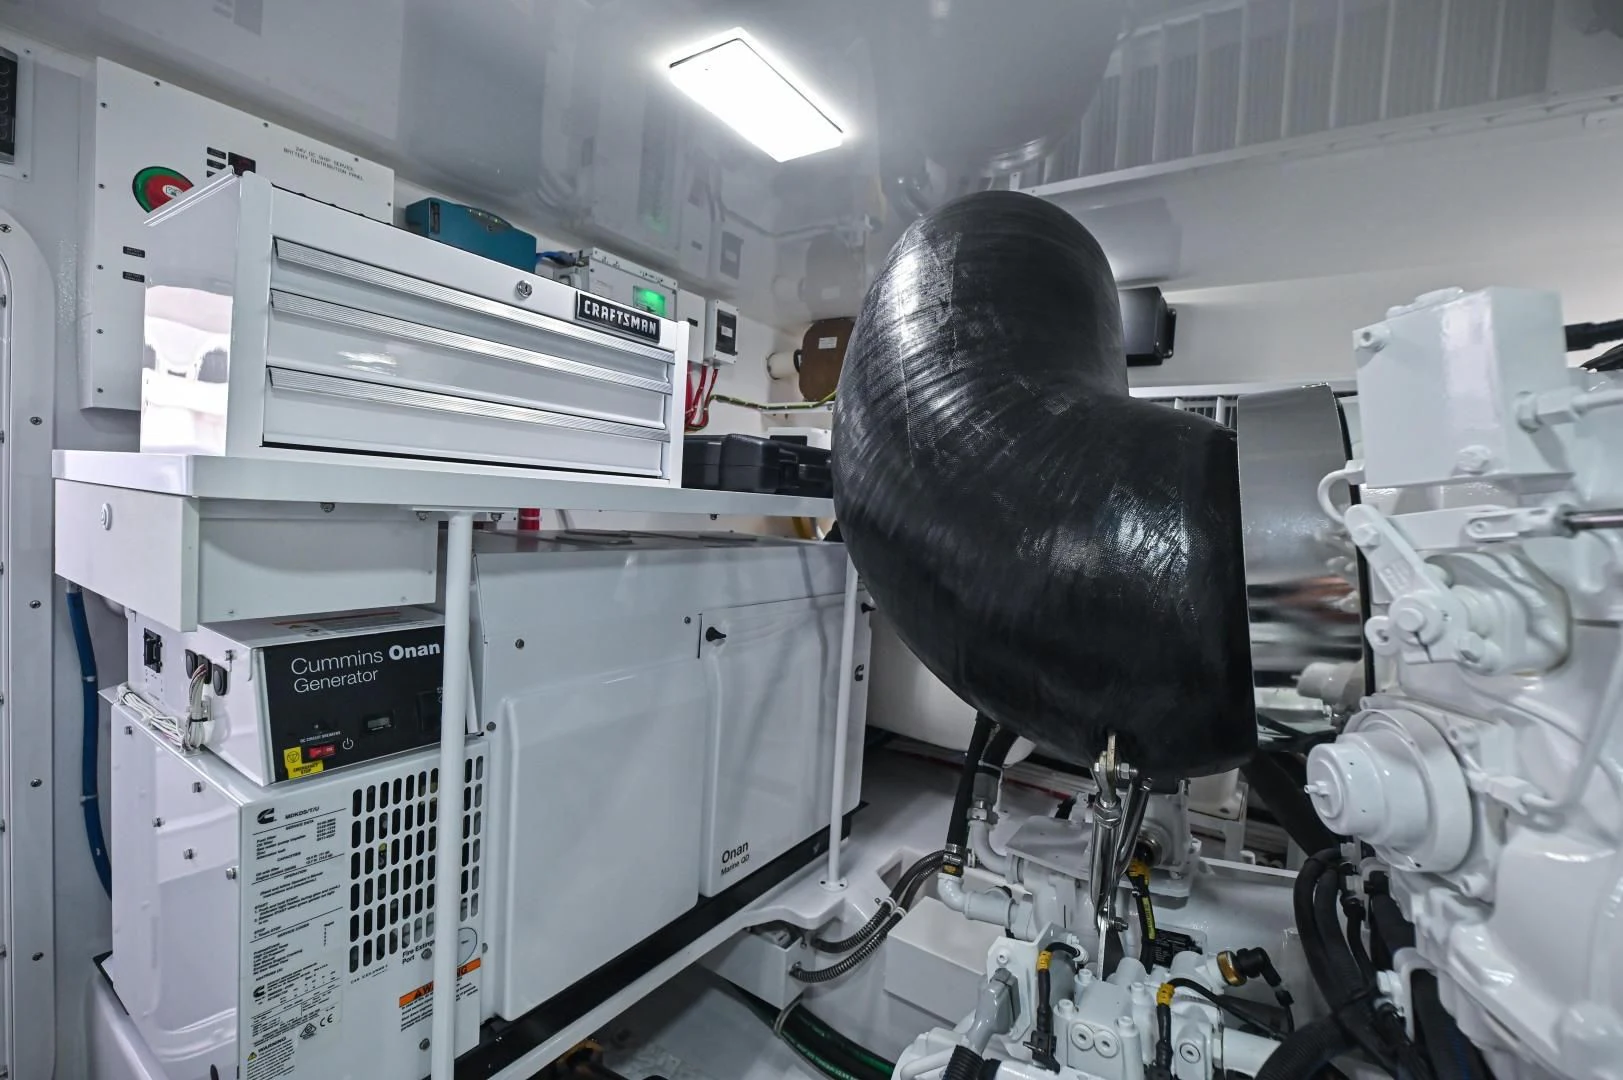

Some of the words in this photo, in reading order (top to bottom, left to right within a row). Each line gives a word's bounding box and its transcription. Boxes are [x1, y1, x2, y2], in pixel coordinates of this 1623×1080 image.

[583, 300, 657, 336] CRAFTSMAN
[290, 650, 384, 676] Cummins
[388, 643, 441, 661] Onan
[293, 669, 379, 693] Generator
[721, 842, 749, 864] Onan
[401, 955, 415, 965] Port
[258, 1037, 287, 1053] WARNING
